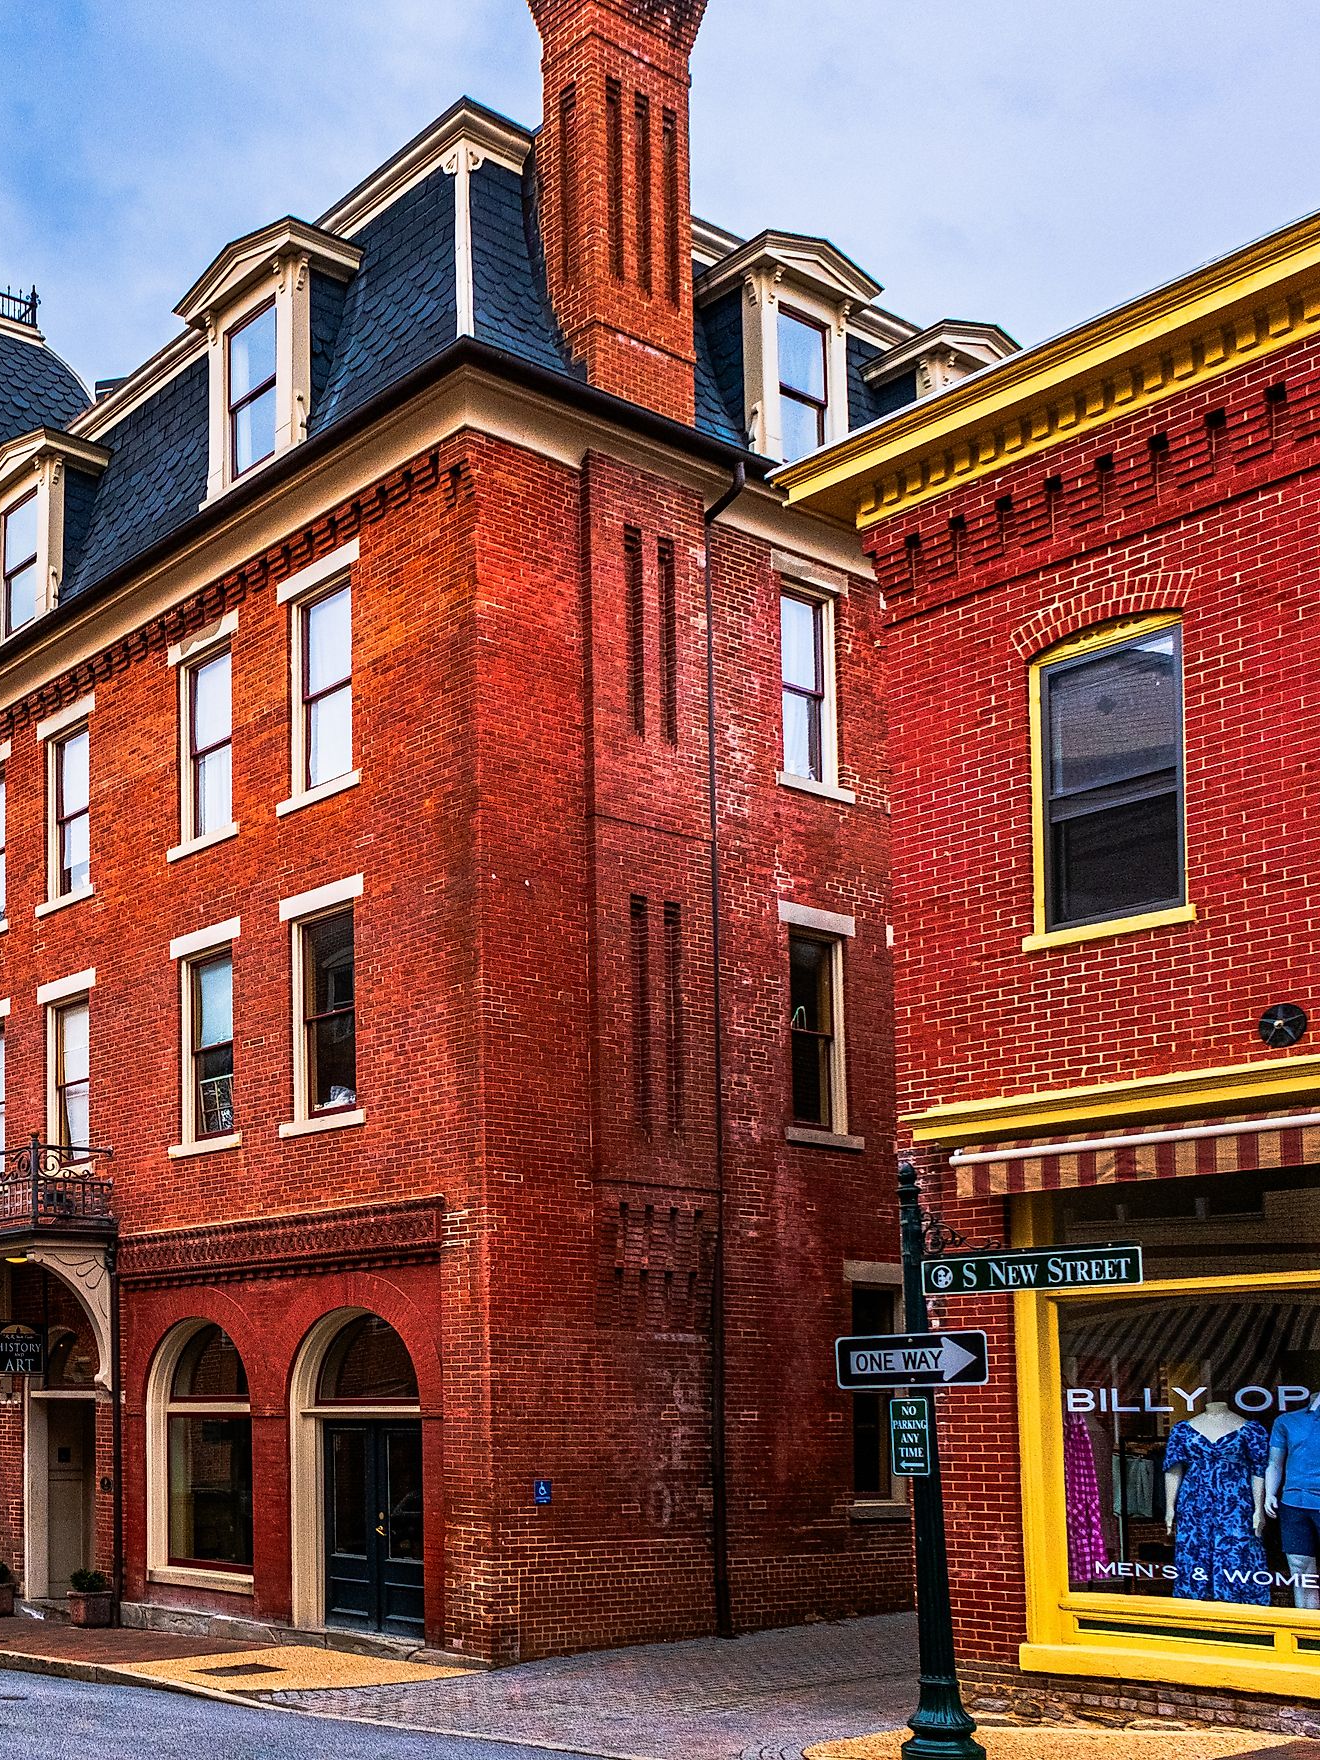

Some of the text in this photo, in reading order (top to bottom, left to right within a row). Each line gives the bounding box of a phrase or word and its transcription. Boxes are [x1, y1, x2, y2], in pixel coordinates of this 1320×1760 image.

[962, 1262, 977, 1288] S
[5, 1358, 35, 1371] ART
[855, 1349, 942, 1372] ONE WAY
[1066, 1386, 1207, 1412] BILLY
[901, 1405, 917, 1416] NO
[892, 1419, 927, 1430] PARKING
[900, 1432, 920, 1444] ANY
[898, 1447, 924, 1458] TIME
[1095, 1560, 1179, 1580] MEN'S
[1192, 1567, 1209, 1581] &
